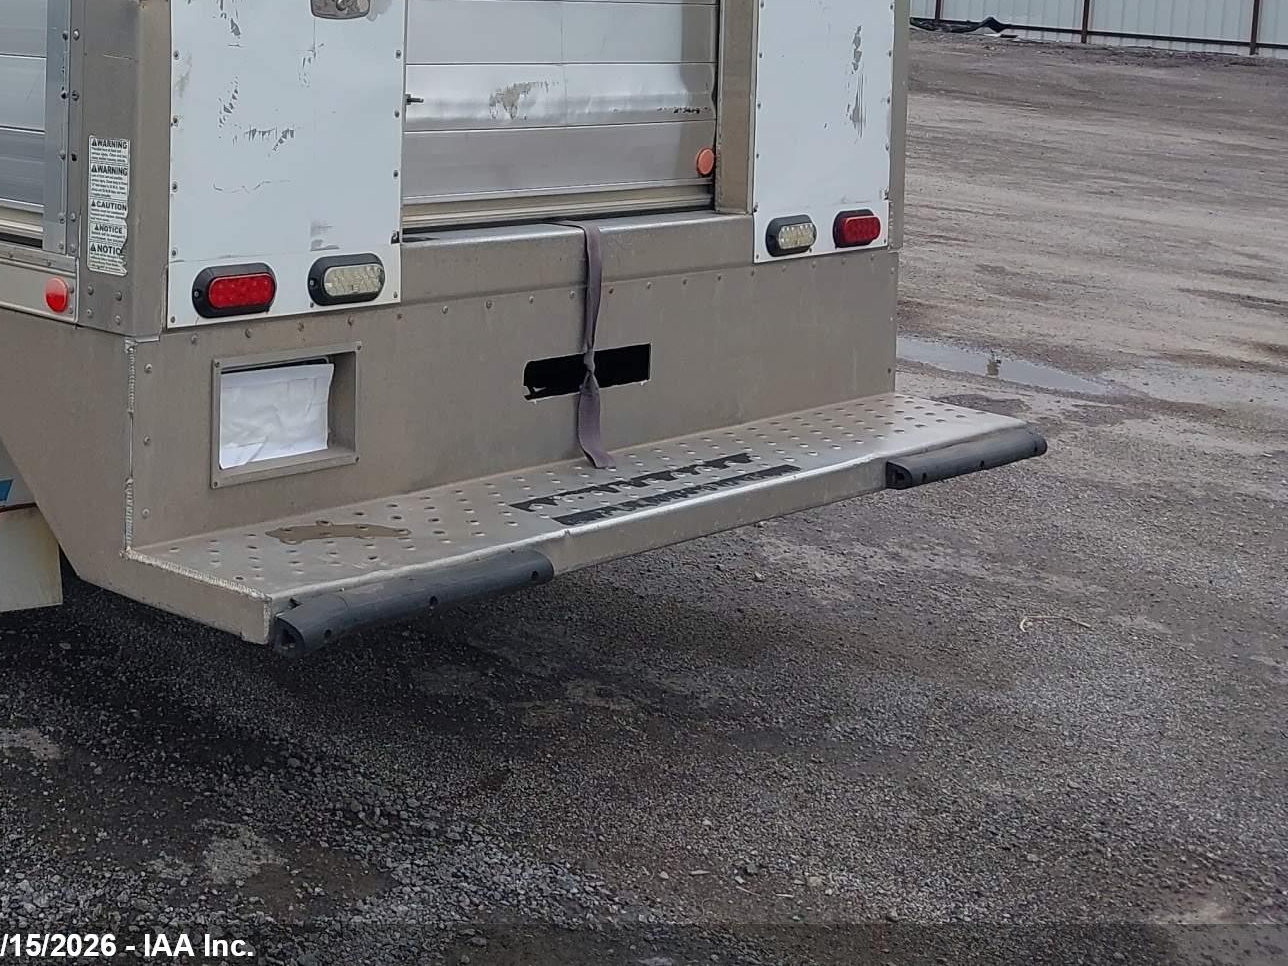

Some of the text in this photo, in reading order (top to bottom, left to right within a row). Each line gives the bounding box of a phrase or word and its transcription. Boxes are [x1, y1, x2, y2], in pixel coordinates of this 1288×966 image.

[97, 139, 128, 150] WARNING
[97, 165, 128, 176] WARNING
[96, 200, 127, 212] CAUTION
[99, 223, 123, 234] NOTICE
[96, 243, 123, 256] NOTIC
